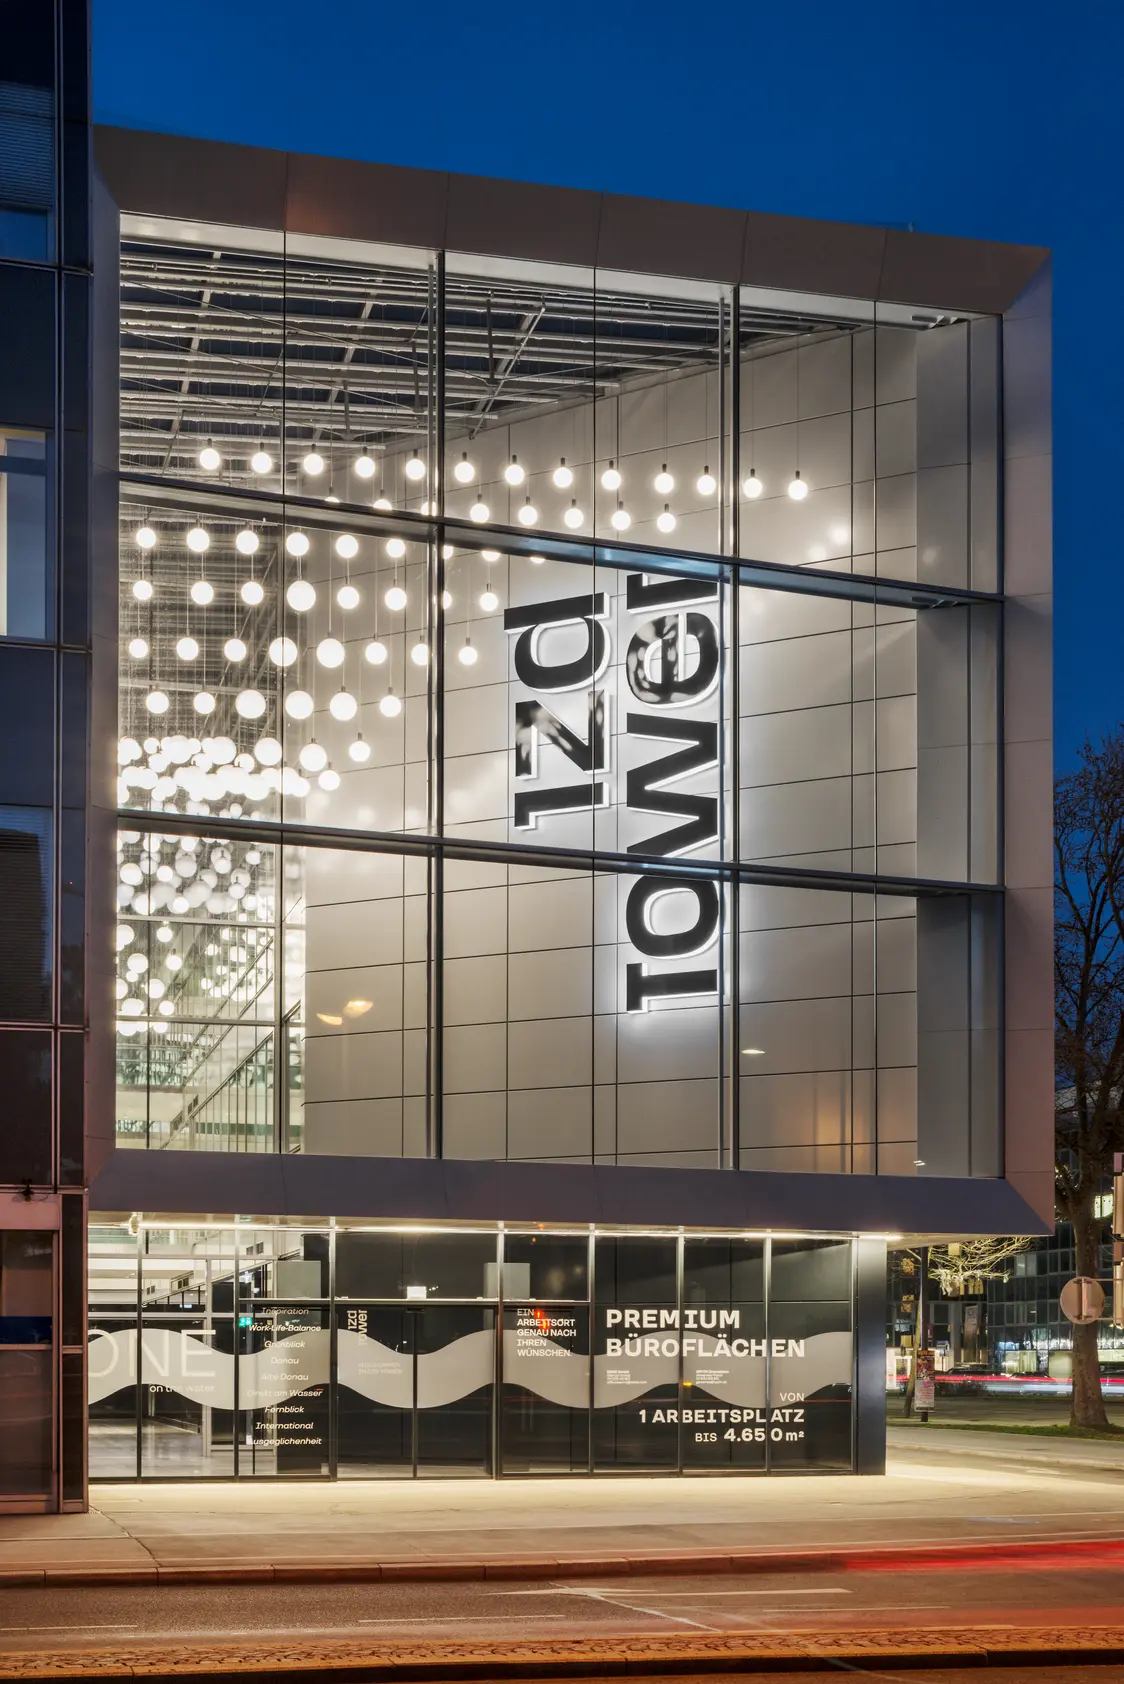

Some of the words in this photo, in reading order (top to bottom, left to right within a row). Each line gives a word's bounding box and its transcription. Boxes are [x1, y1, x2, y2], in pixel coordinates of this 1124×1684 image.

[261, 1307, 309, 1315] Inspiration
[517, 1308, 535, 1317] EIN
[516, 1318, 576, 1327] ARBEITSORT
[606, 1309, 740, 1329] PREMIUM
[516, 1329, 549, 1337] GENAU
[550, 1329, 577, 1337] NACH
[516, 1338, 547, 1347] IHREN
[606, 1333, 805, 1358] BÜROFLÄCHEN
[271, 1357, 300, 1365] Donau
[280, 1373, 309, 1381] Donau
[149, 1385, 164, 1393] on
[289, 1389, 323, 1397] Wasser
[779, 1392, 805, 1402] VON
[264, 1405, 305, 1413] Fernblick
[639, 1409, 647, 1423] 1
[255, 1421, 314, 1430] International
[695, 1433, 718, 1442] BIS
